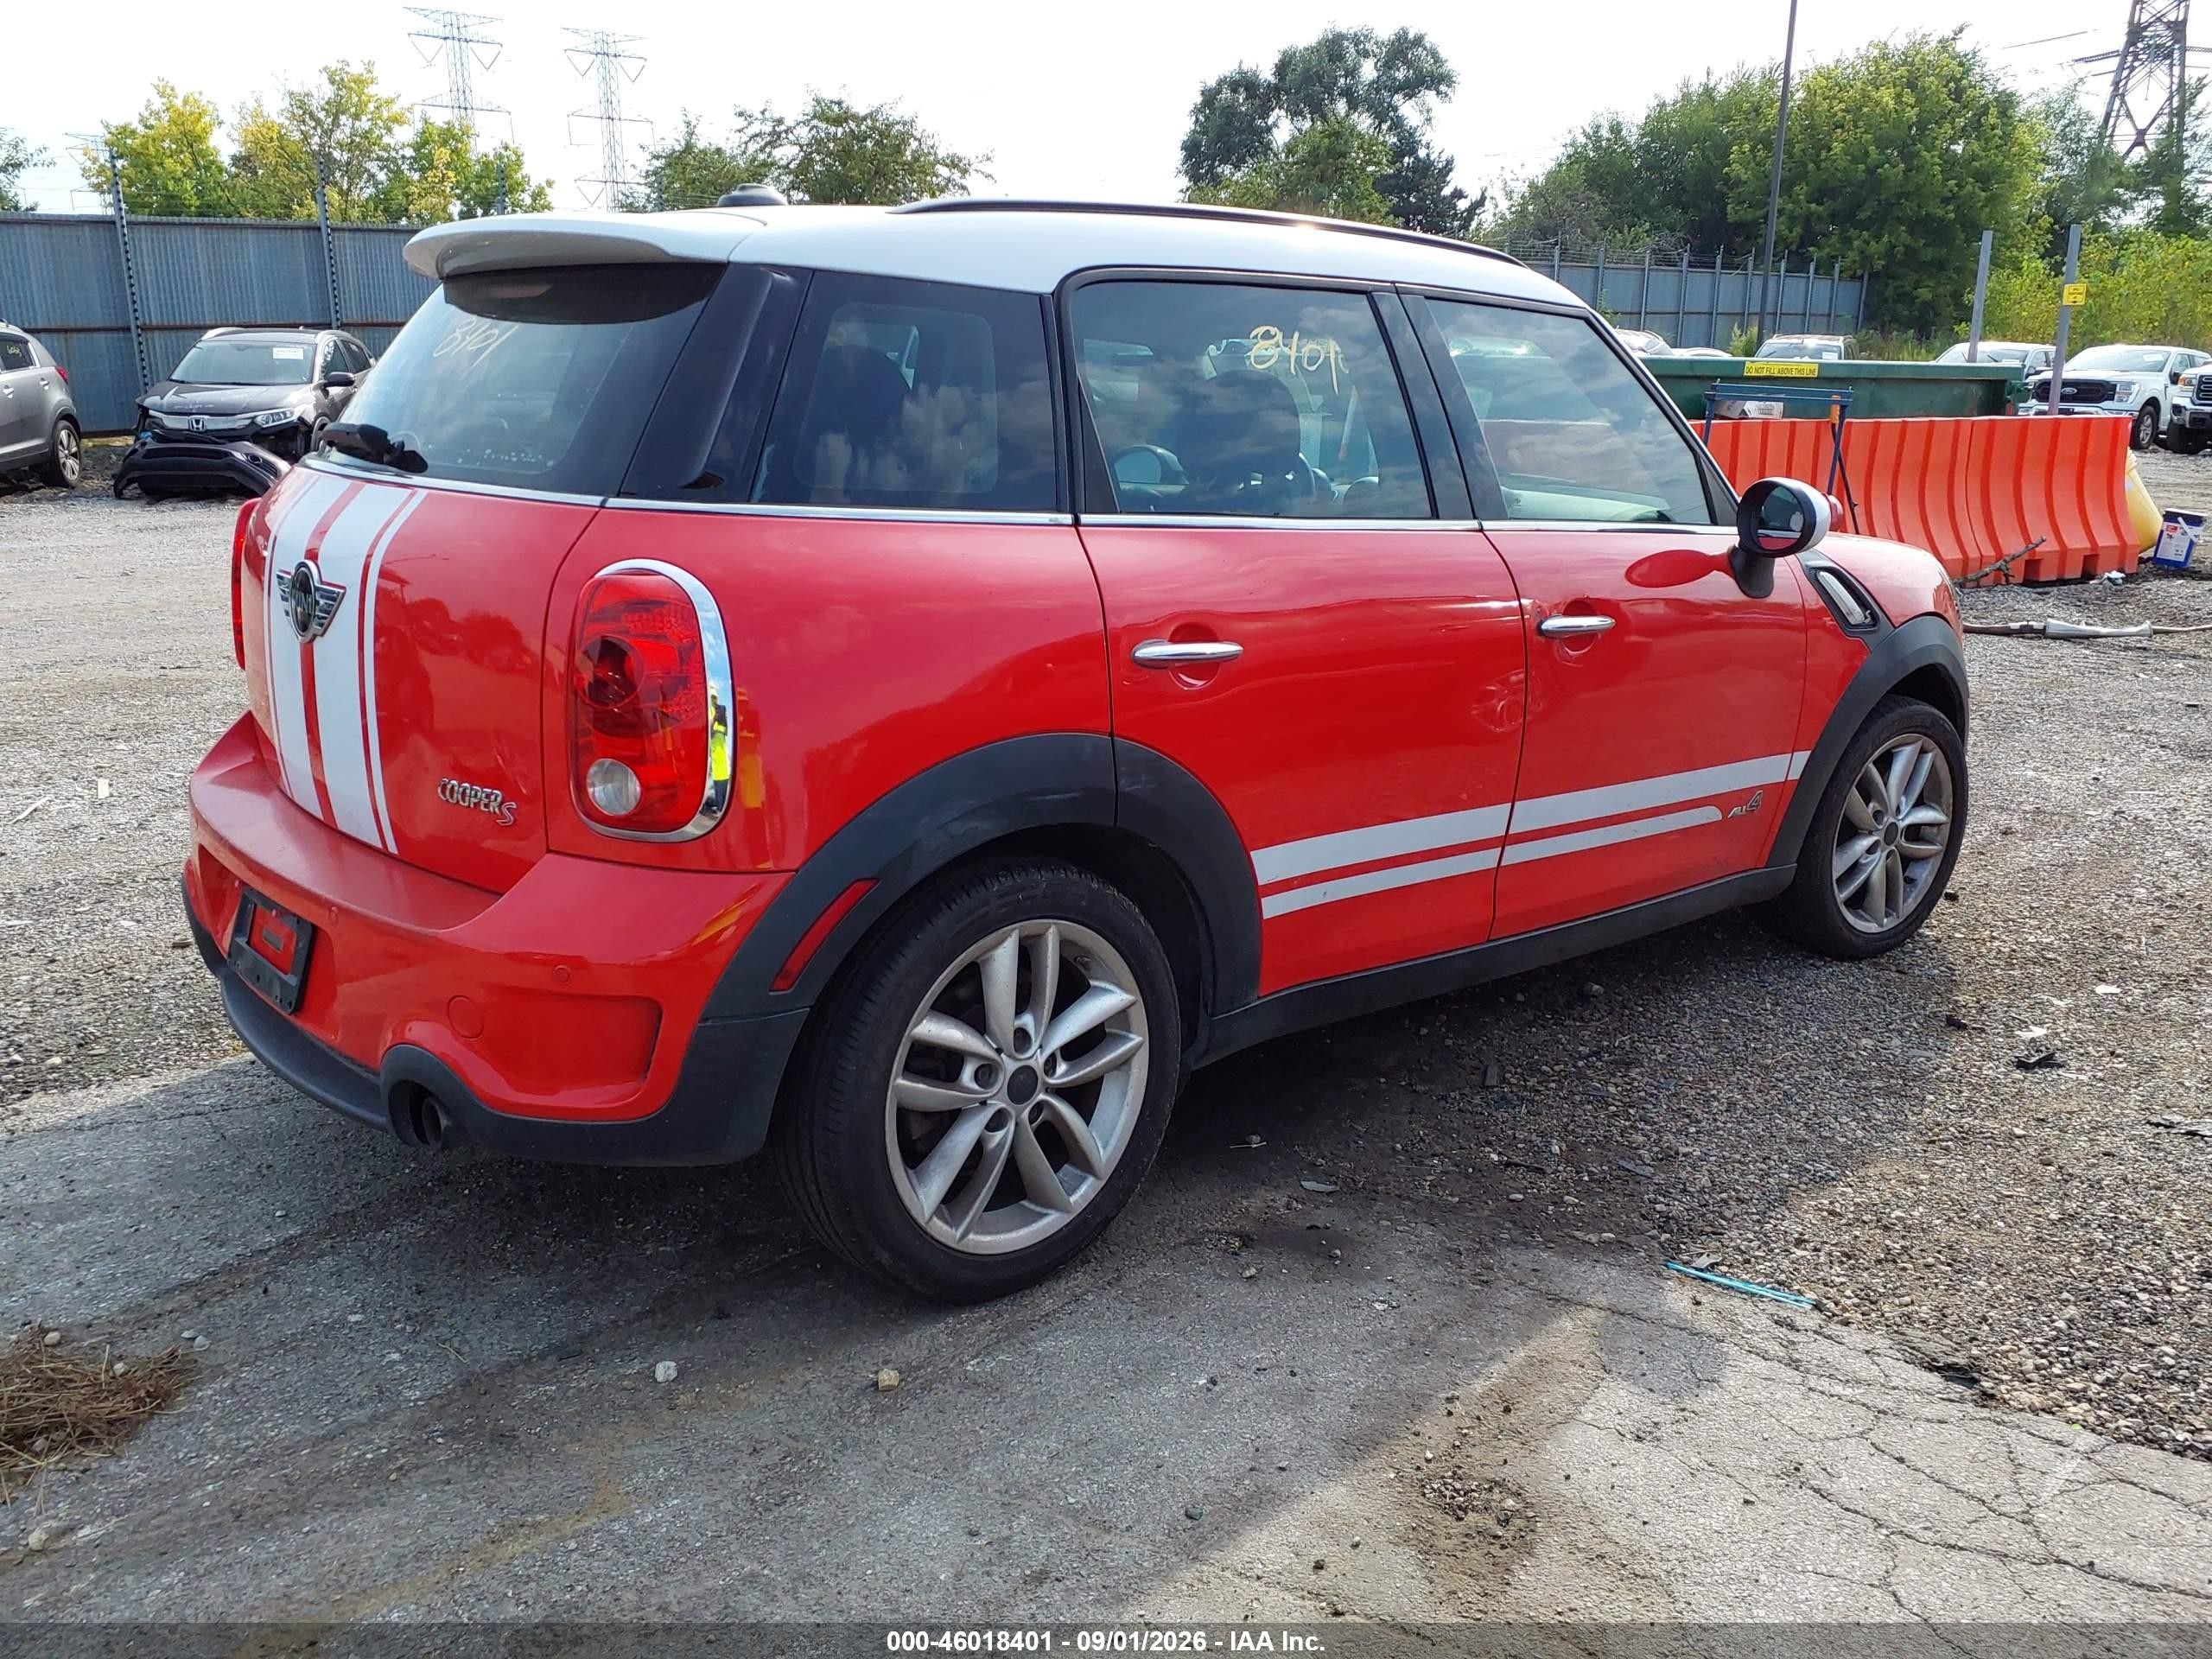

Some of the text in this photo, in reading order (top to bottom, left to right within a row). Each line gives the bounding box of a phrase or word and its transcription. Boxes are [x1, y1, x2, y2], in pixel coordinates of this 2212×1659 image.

[433, 317, 519, 371] 8401
[1249, 325, 1341, 395] 8401
[1745, 365, 1753, 374] DO
[1765, 366, 1777, 375] FILL
[1794, 367, 1805, 376] THIS
[1805, 368, 1816, 377] LINE
[437, 778, 517, 826] COOPER S
